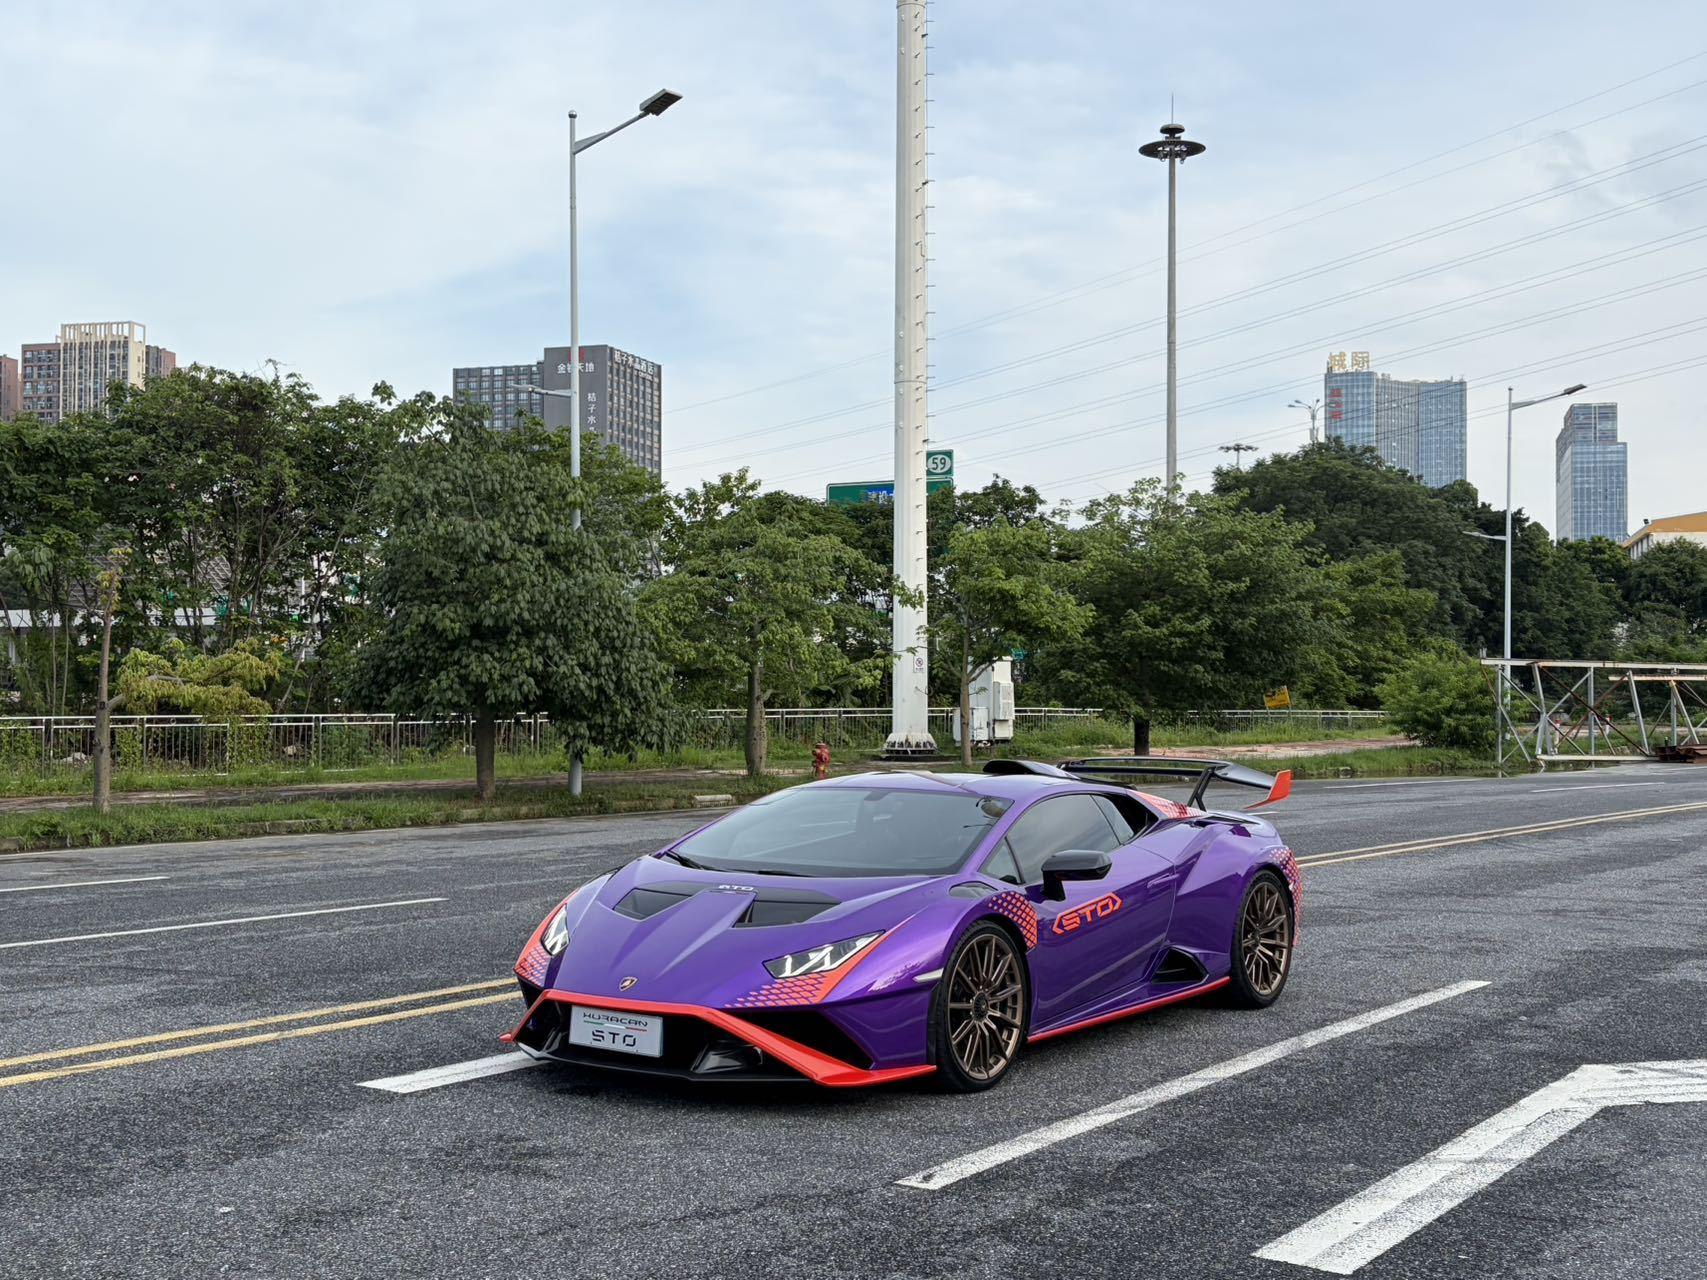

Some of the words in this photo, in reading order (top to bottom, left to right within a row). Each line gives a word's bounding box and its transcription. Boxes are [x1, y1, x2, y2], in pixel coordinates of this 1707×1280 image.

[931, 457, 947, 471] 59
[1061, 897, 1115, 931] STO
[592, 1029, 637, 1047] STO
